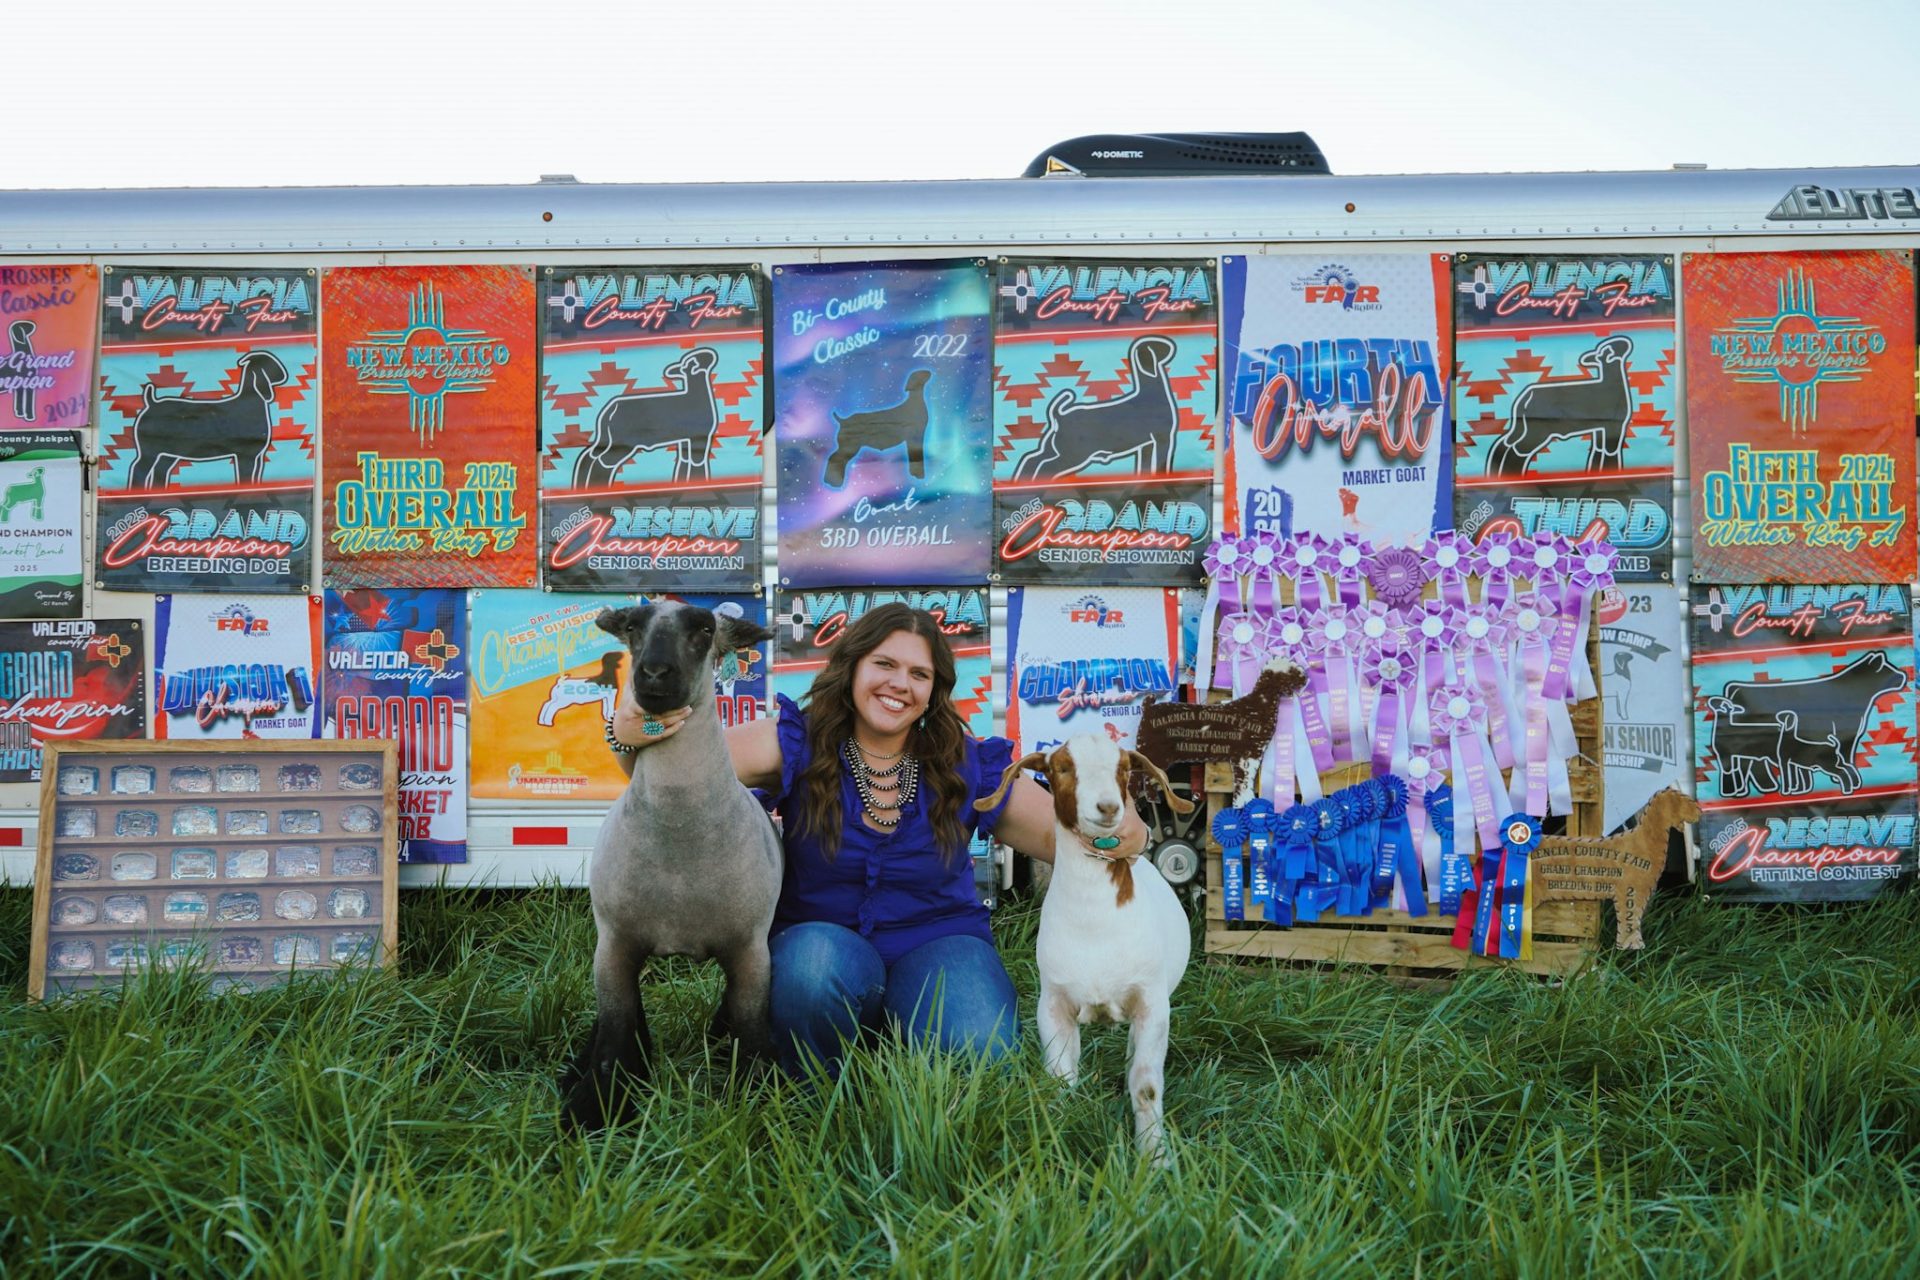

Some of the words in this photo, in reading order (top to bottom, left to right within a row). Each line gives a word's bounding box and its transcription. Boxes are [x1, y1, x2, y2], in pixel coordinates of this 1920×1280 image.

[1103, 150, 1143, 159] DOMETIC
[1792, 185, 1918, 219] ELITE
[2, 268, 72, 285] ROSSES
[1027, 265, 1212, 305] VALENCIA
[1486, 262, 1672, 300] VALENCIA
[1, 286, 76, 314] lassic
[131, 275, 314, 315] VALENCIA
[576, 273, 760, 312] VALENCIA
[1037, 287, 1126, 321] County
[1136, 287, 1197, 321] Fair
[1305, 283, 1380, 306] FAIR
[1496, 282, 1586, 318] County
[1596, 282, 1656, 318] Fair
[142, 297, 230, 333] County
[239, 297, 298, 333] Fair
[583, 293, 673, 330] County
[683, 293, 743, 329] Fair
[346, 347, 404, 367] NEW
[412, 343, 510, 367] MEXICO
[813, 326, 880, 364] Classic
[912, 333, 967, 358] 2022
[1711, 334, 1775, 355] NEW
[1782, 332, 1886, 354] MEXICO
[8, 350, 75, 373] Grand
[357, 363, 426, 379] Breeders
[433, 361, 494, 379] Classic
[1723, 352, 1800, 369] Breeders
[1805, 352, 1869, 368] Classic
[0, 371, 56, 394] mpion
[1232, 337, 1444, 416] FOURTH
[43, 394, 86, 425] 2024
[1253, 362, 1434, 460] Overall
[35, 435, 74, 443] Jackpot
[357, 451, 444, 490] THIRD
[465, 462, 518, 490] 2024
[1729, 443, 1819, 482] FIFTH
[1840, 454, 1896, 482] 2024
[1343, 469, 1391, 486] MARKET
[1396, 466, 1426, 482] GOAT
[335, 479, 527, 529] OVERALL
[854, 487, 921, 523] Goat
[1254, 492, 1281, 517] 20
[1703, 471, 1906, 523] OVERALL
[14, 529, 72, 537] CHAMPION
[106, 506, 149, 541] 2025
[159, 508, 310, 552] GRAND
[551, 505, 593, 542] 2025
[609, 506, 758, 540] RESERVE
[1002, 497, 1045, 534] 2025
[1055, 498, 1210, 544] GRAND
[1511, 497, 1672, 551] THIRD
[105, 517, 290, 568] Champion
[331, 525, 424, 554] Wether
[431, 526, 489, 558] Ring
[494, 525, 519, 553] B
[552, 516, 740, 568] Champion
[820, 527, 860, 548] 3RD
[867, 524, 954, 547] OVERALL
[1002, 508, 1190, 559] Champion
[1701, 520, 1796, 548] Wether
[1804, 520, 1866, 552] Ring
[1869, 519, 1905, 546] A
[147, 556, 245, 574] BREEDING
[250, 556, 291, 574] DOE
[588, 556, 652, 570] SENIOR
[655, 556, 744, 570] SHOWMAN
[1038, 548, 1103, 563] SENIOR
[1106, 549, 1194, 564] SHOWMAN
[1615, 556, 1650, 572] MB
[556, 604, 580, 616] TWO
[1630, 595, 1652, 613] 23
[1719, 584, 1910, 619] VALENCIA
[33, 622, 96, 636] VALENCIA
[217, 618, 269, 634] FAIR
[1071, 610, 1123, 626] FAIR
[1733, 601, 1822, 638] County
[1832, 600, 1894, 636] Fair
[47, 636, 82, 648] county
[82, 638, 110, 650] fair
[507, 629, 542, 646] RES.
[1617, 630, 1652, 649] CAMP
[330, 651, 409, 669] VALENCIA
[480, 620, 607, 691] Champio
[1, 651, 73, 699] GRAND
[163, 663, 288, 711] DIVISION
[374, 662, 431, 687] county
[428, 667, 463, 687] fair
[1018, 658, 1172, 700] CHAMPION
[563, 684, 612, 695] 2024
[255, 718, 284, 730] MARKET
[288, 717, 306, 729] GOAT
[1102, 706, 1129, 717] SENIOR
[1198, 709, 1237, 724] COUNTY
[1210, 744, 1231, 753] GOAT
[1618, 726, 1672, 760] SENIOR
[1604, 754, 1645, 768] ANSHIP
[398, 772, 456, 790] pion
[398, 790, 452, 814] RKET
[1709, 818, 1749, 855] 2025
[1764, 815, 1915, 849] RESERVE
[1575, 845, 1620, 860] COUNTY
[1624, 852, 1651, 871] FAIR
[1711, 828, 1899, 880] Champion
[1541, 863, 1571, 875] GRAND
[1575, 865, 1623, 877] CHAMPION
[1751, 866, 1817, 882] FITTING
[1820, 864, 1902, 880] CONTEST
[1548, 880, 1593, 891] BREEDING
[1596, 882, 1613, 893] DOE
